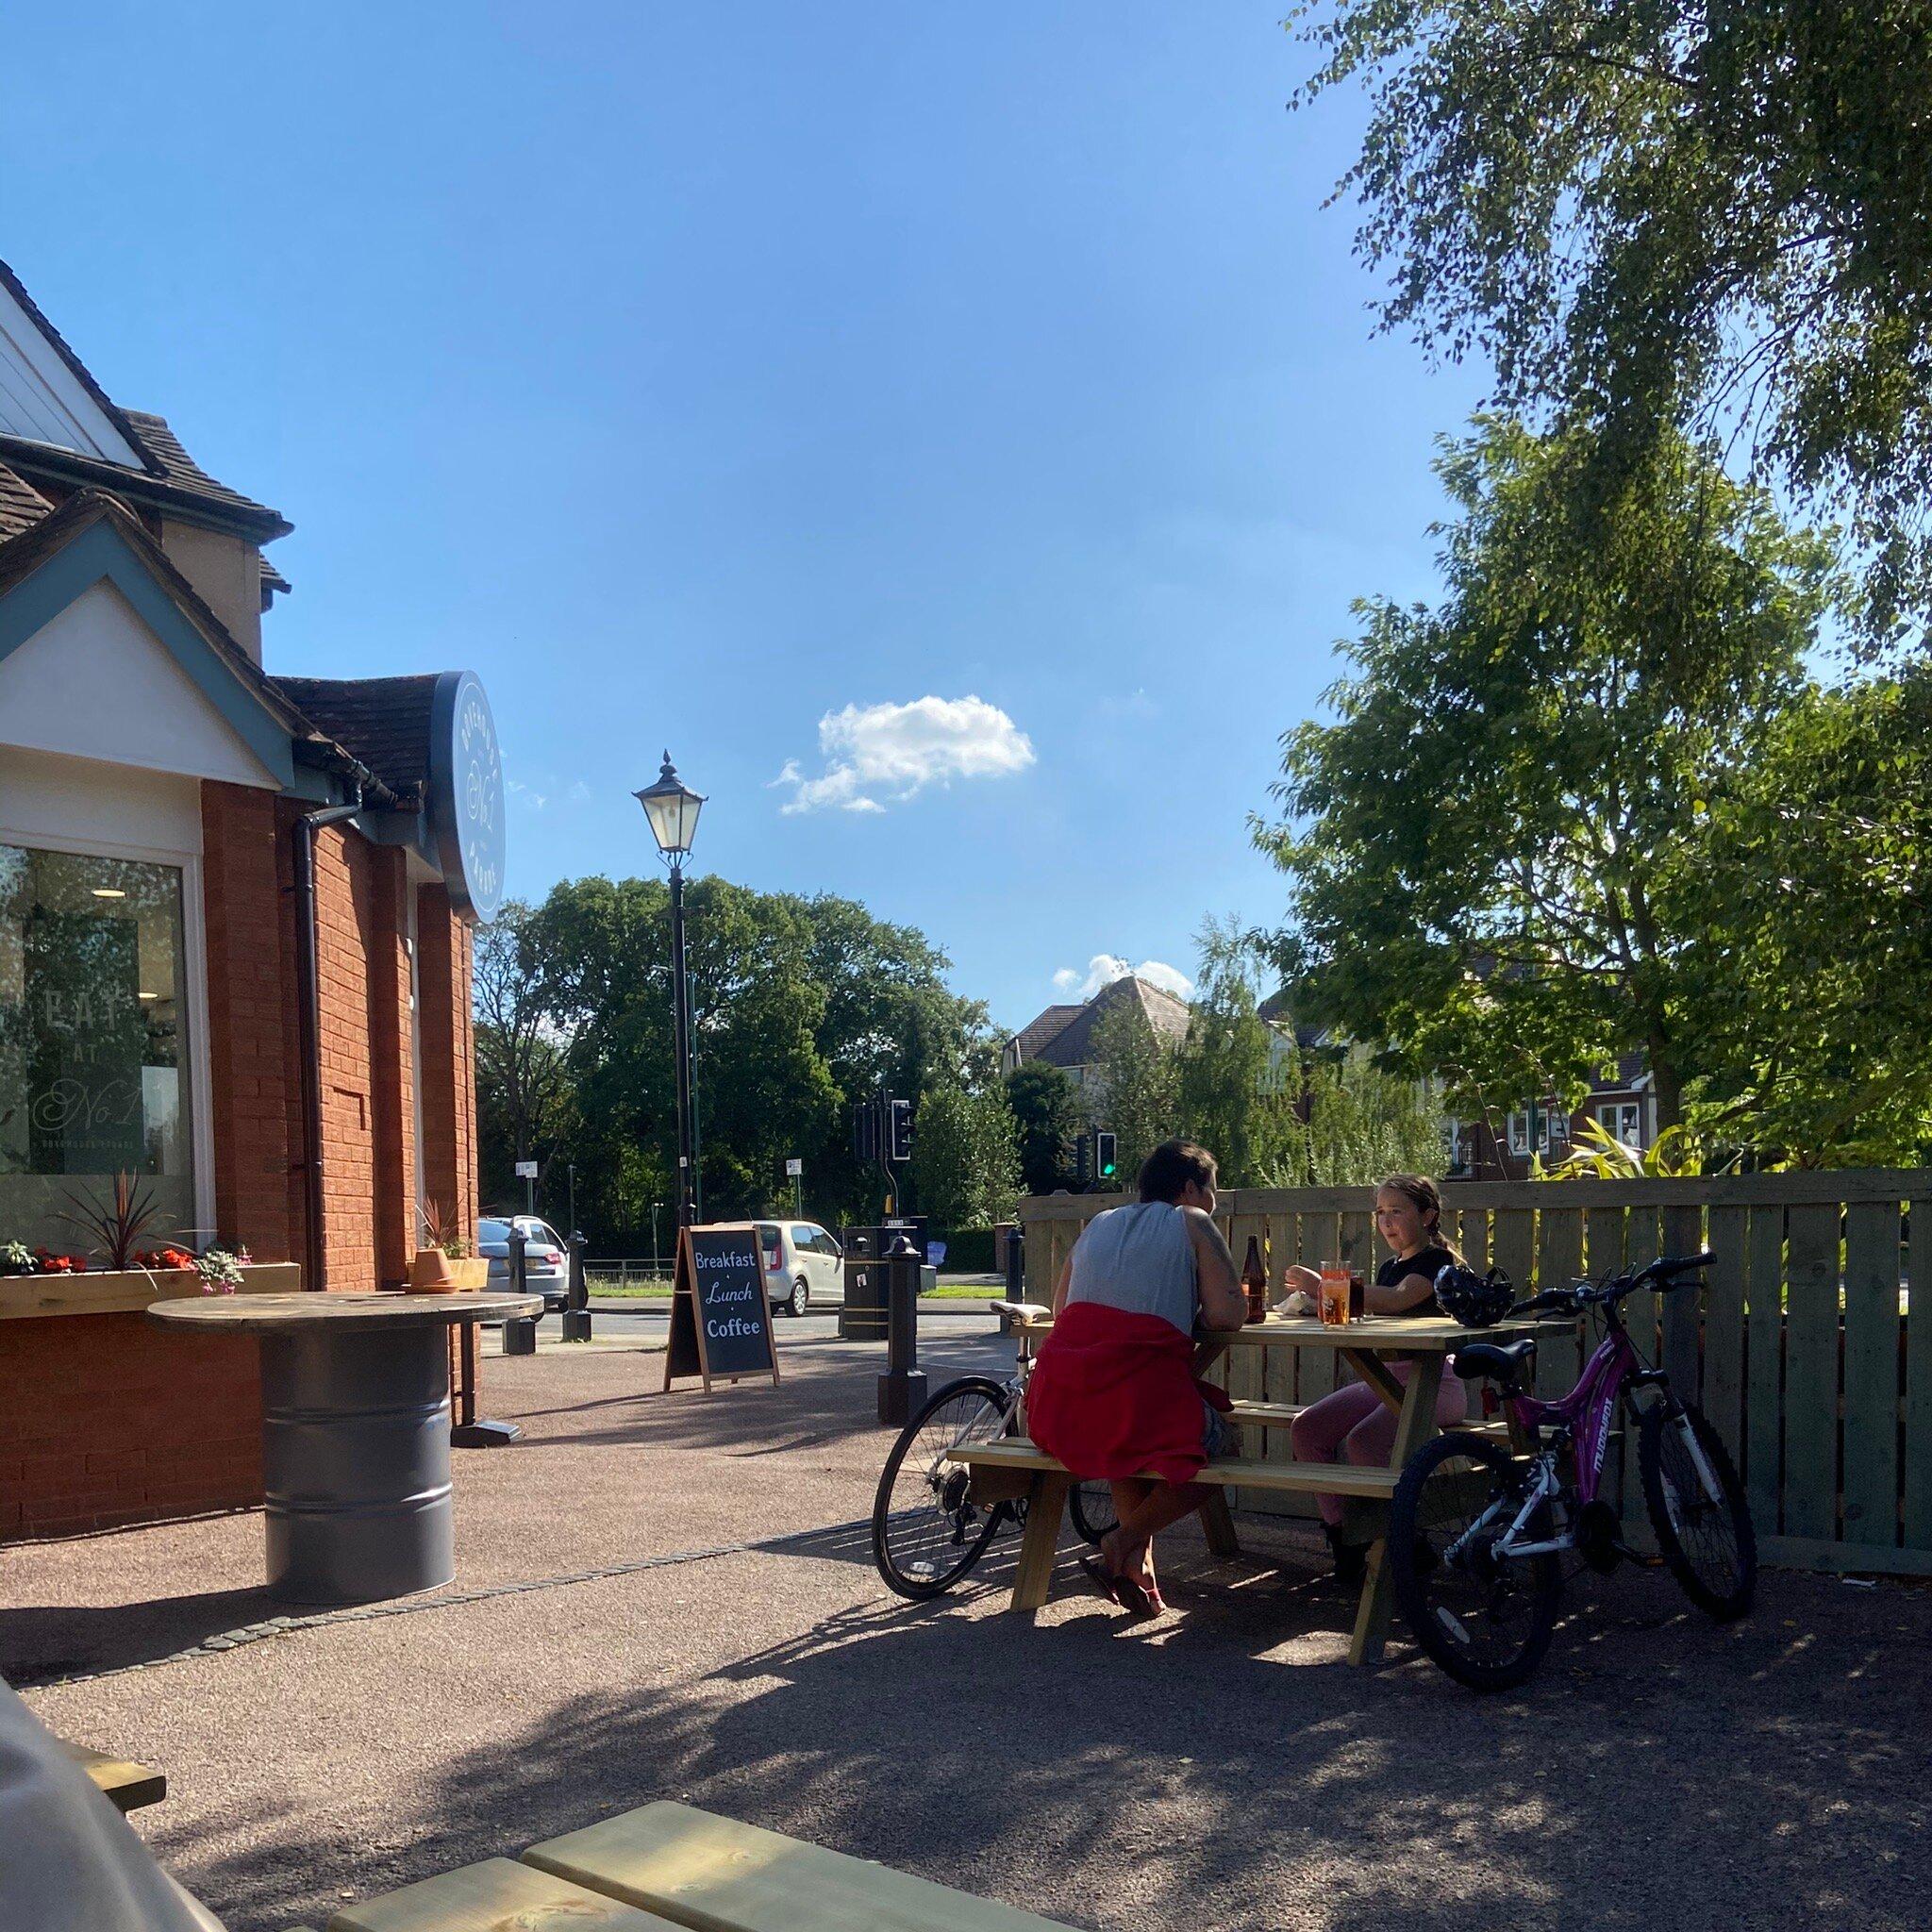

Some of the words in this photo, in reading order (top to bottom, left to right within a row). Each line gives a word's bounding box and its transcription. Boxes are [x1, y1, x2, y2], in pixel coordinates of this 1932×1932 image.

[75, 1042, 97, 1063] AT
[695, 1251, 757, 1270] Breakfast
[705, 1281, 753, 1305] Lunch
[707, 1317, 760, 1338] Coffee
